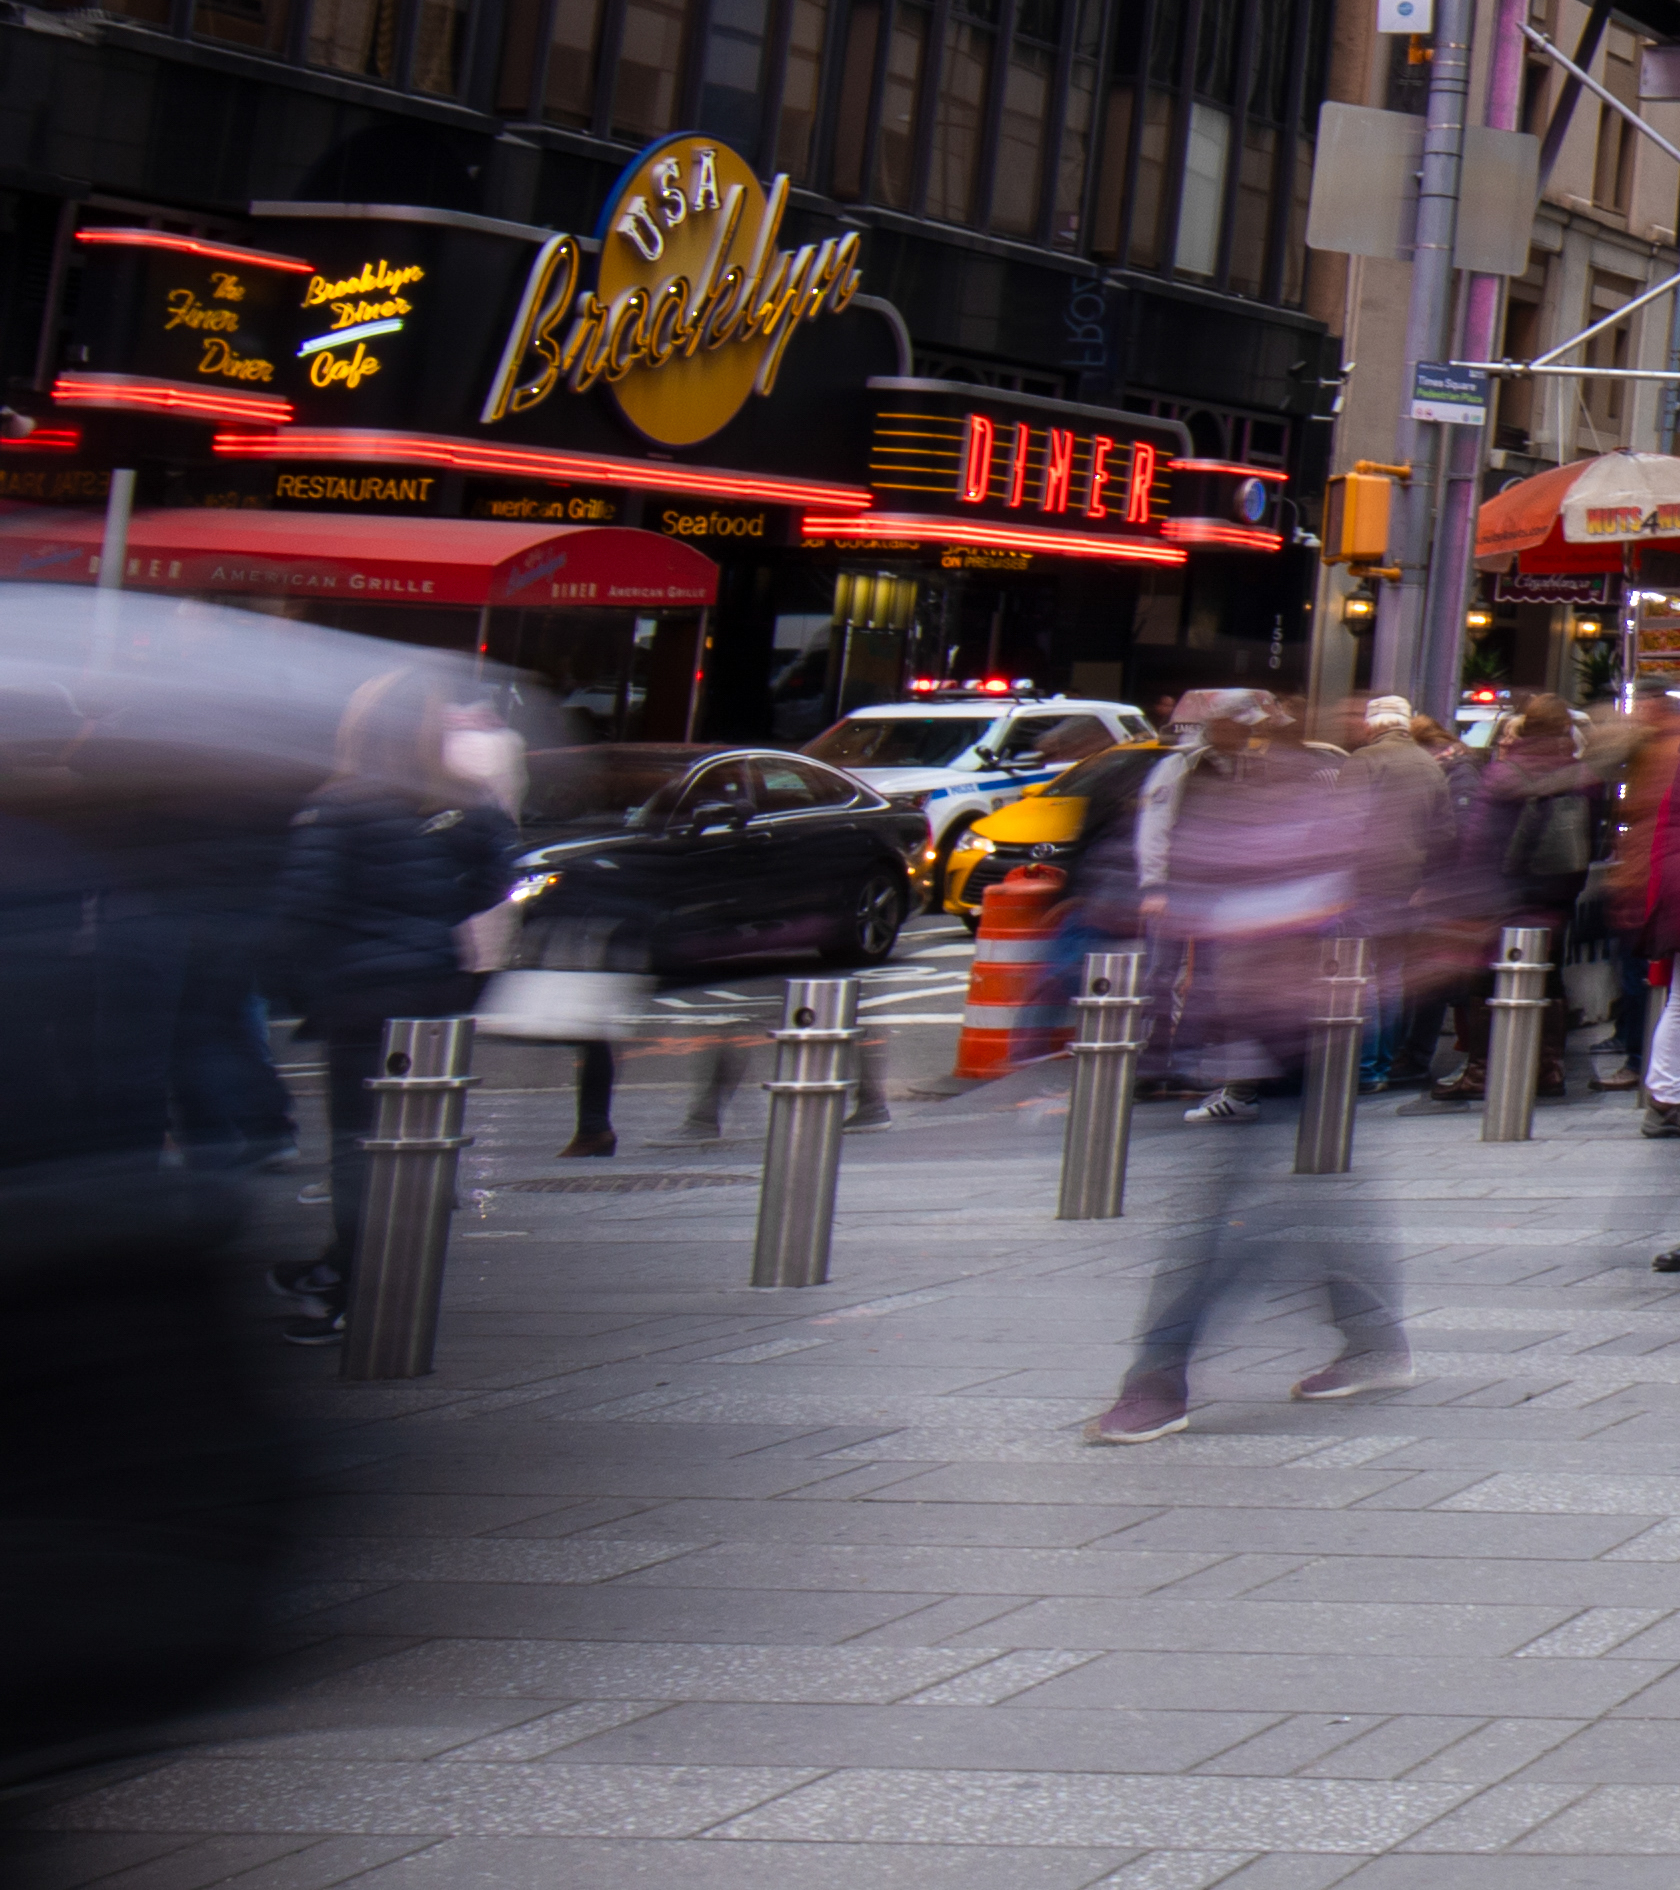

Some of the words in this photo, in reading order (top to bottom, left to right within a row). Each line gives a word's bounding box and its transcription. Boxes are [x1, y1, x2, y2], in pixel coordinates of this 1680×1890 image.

[616, 148, 720, 261] USA
[210, 272, 246, 302] The
[302, 259, 426, 307] Brooklyn
[480, 174, 861, 423] Brooklyn
[165, 289, 239, 332] Finer
[330, 296, 412, 330] Diner
[199, 337, 275, 383] Diner
[310, 342, 381, 389] Cafe
[277, 474, 434, 502] RESTAURANT
[963, 414, 1155, 523] DINER
[661, 510, 765, 537] Seafood
[89, 555, 182, 579] DNER
[349, 573, 435, 595] GRILLE
[941, 556, 962, 569] ON
[667, 585, 706, 598] GRILLE
